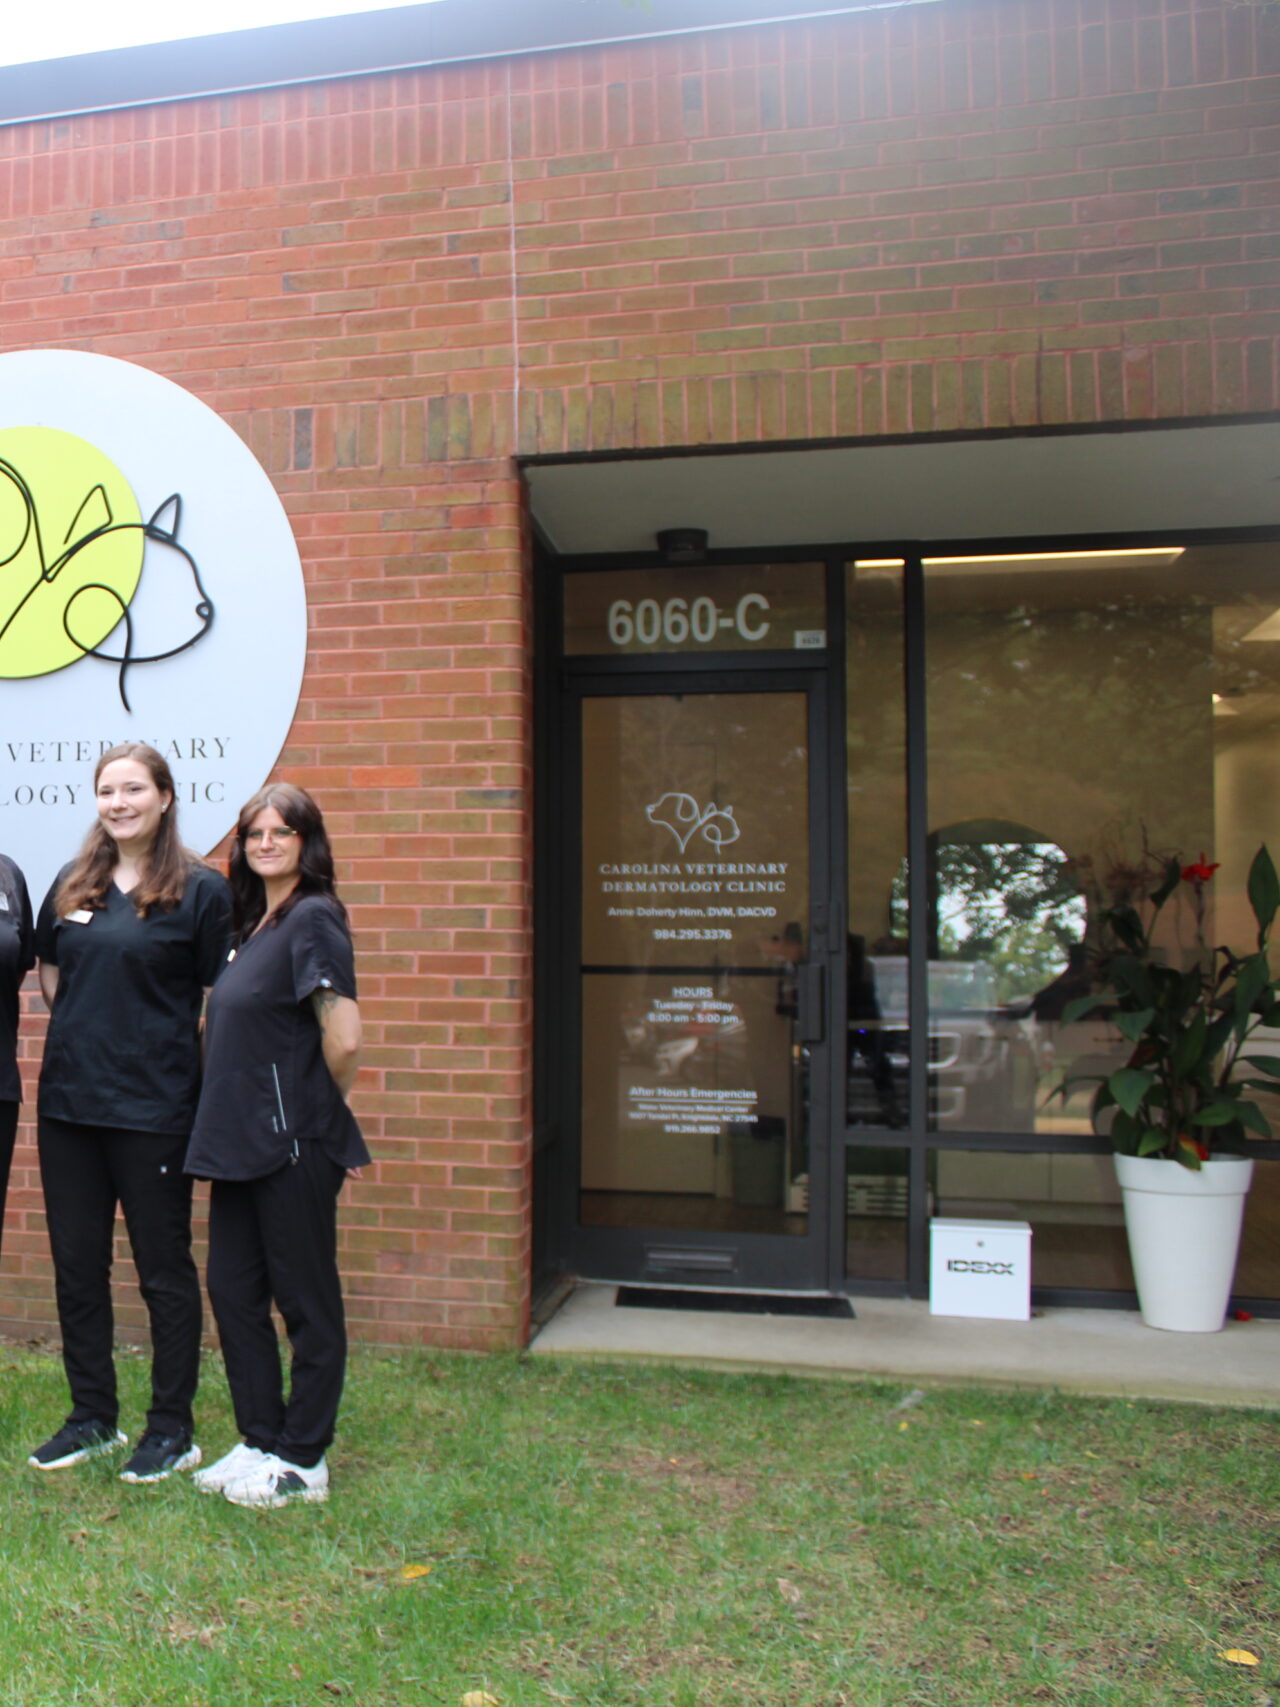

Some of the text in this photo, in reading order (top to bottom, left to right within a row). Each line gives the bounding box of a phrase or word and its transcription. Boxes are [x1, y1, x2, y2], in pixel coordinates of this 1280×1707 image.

[608, 592, 770, 645] 6060-C
[6, 737, 231, 763] VETEARY
[599, 863, 788, 874] CAROLINA VETERINARY
[602, 881, 786, 893] DERMATOLOGY CLINIC
[707, 907, 735, 918] DVM,
[736, 907, 777, 917] DACVD
[672, 987, 713, 998] HOURS
[657, 1087, 688, 1096] Hours
[690, 1088, 757, 1099] Emergencies
[947, 1259, 1015, 1275] IDEXX
